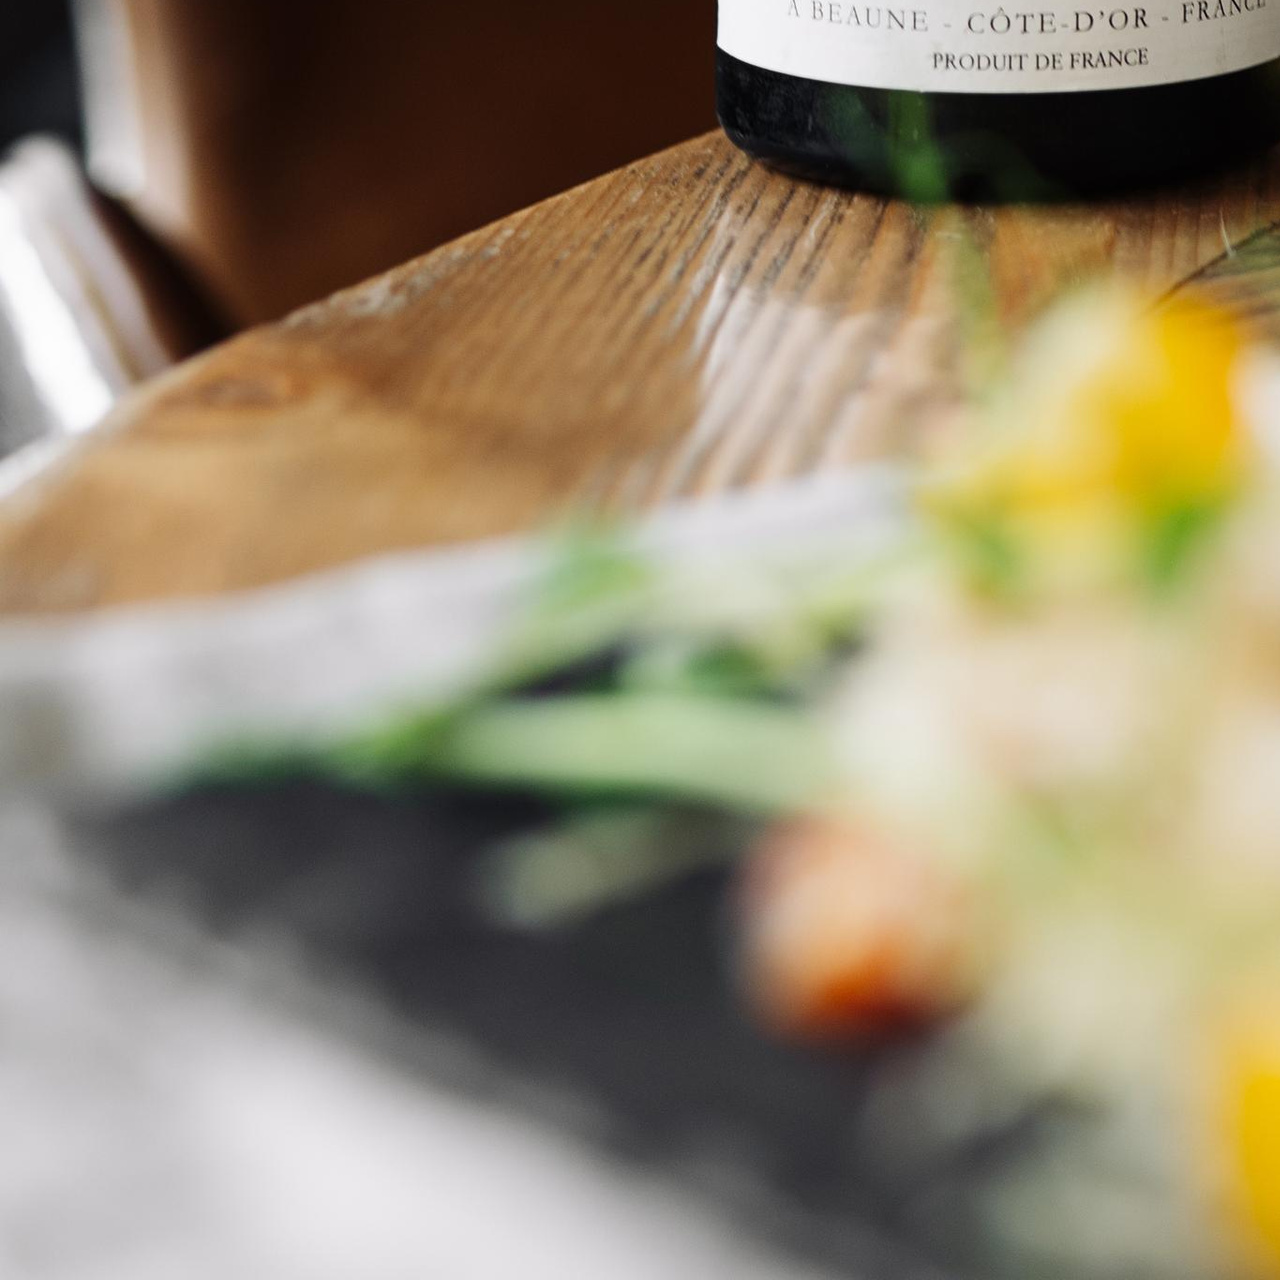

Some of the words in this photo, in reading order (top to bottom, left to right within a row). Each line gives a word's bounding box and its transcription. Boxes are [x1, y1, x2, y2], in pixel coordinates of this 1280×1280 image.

[932, 52, 1029, 71] PRODUIT
[1035, 53, 1064, 71] DE
[1069, 47, 1150, 71] FRANCE
